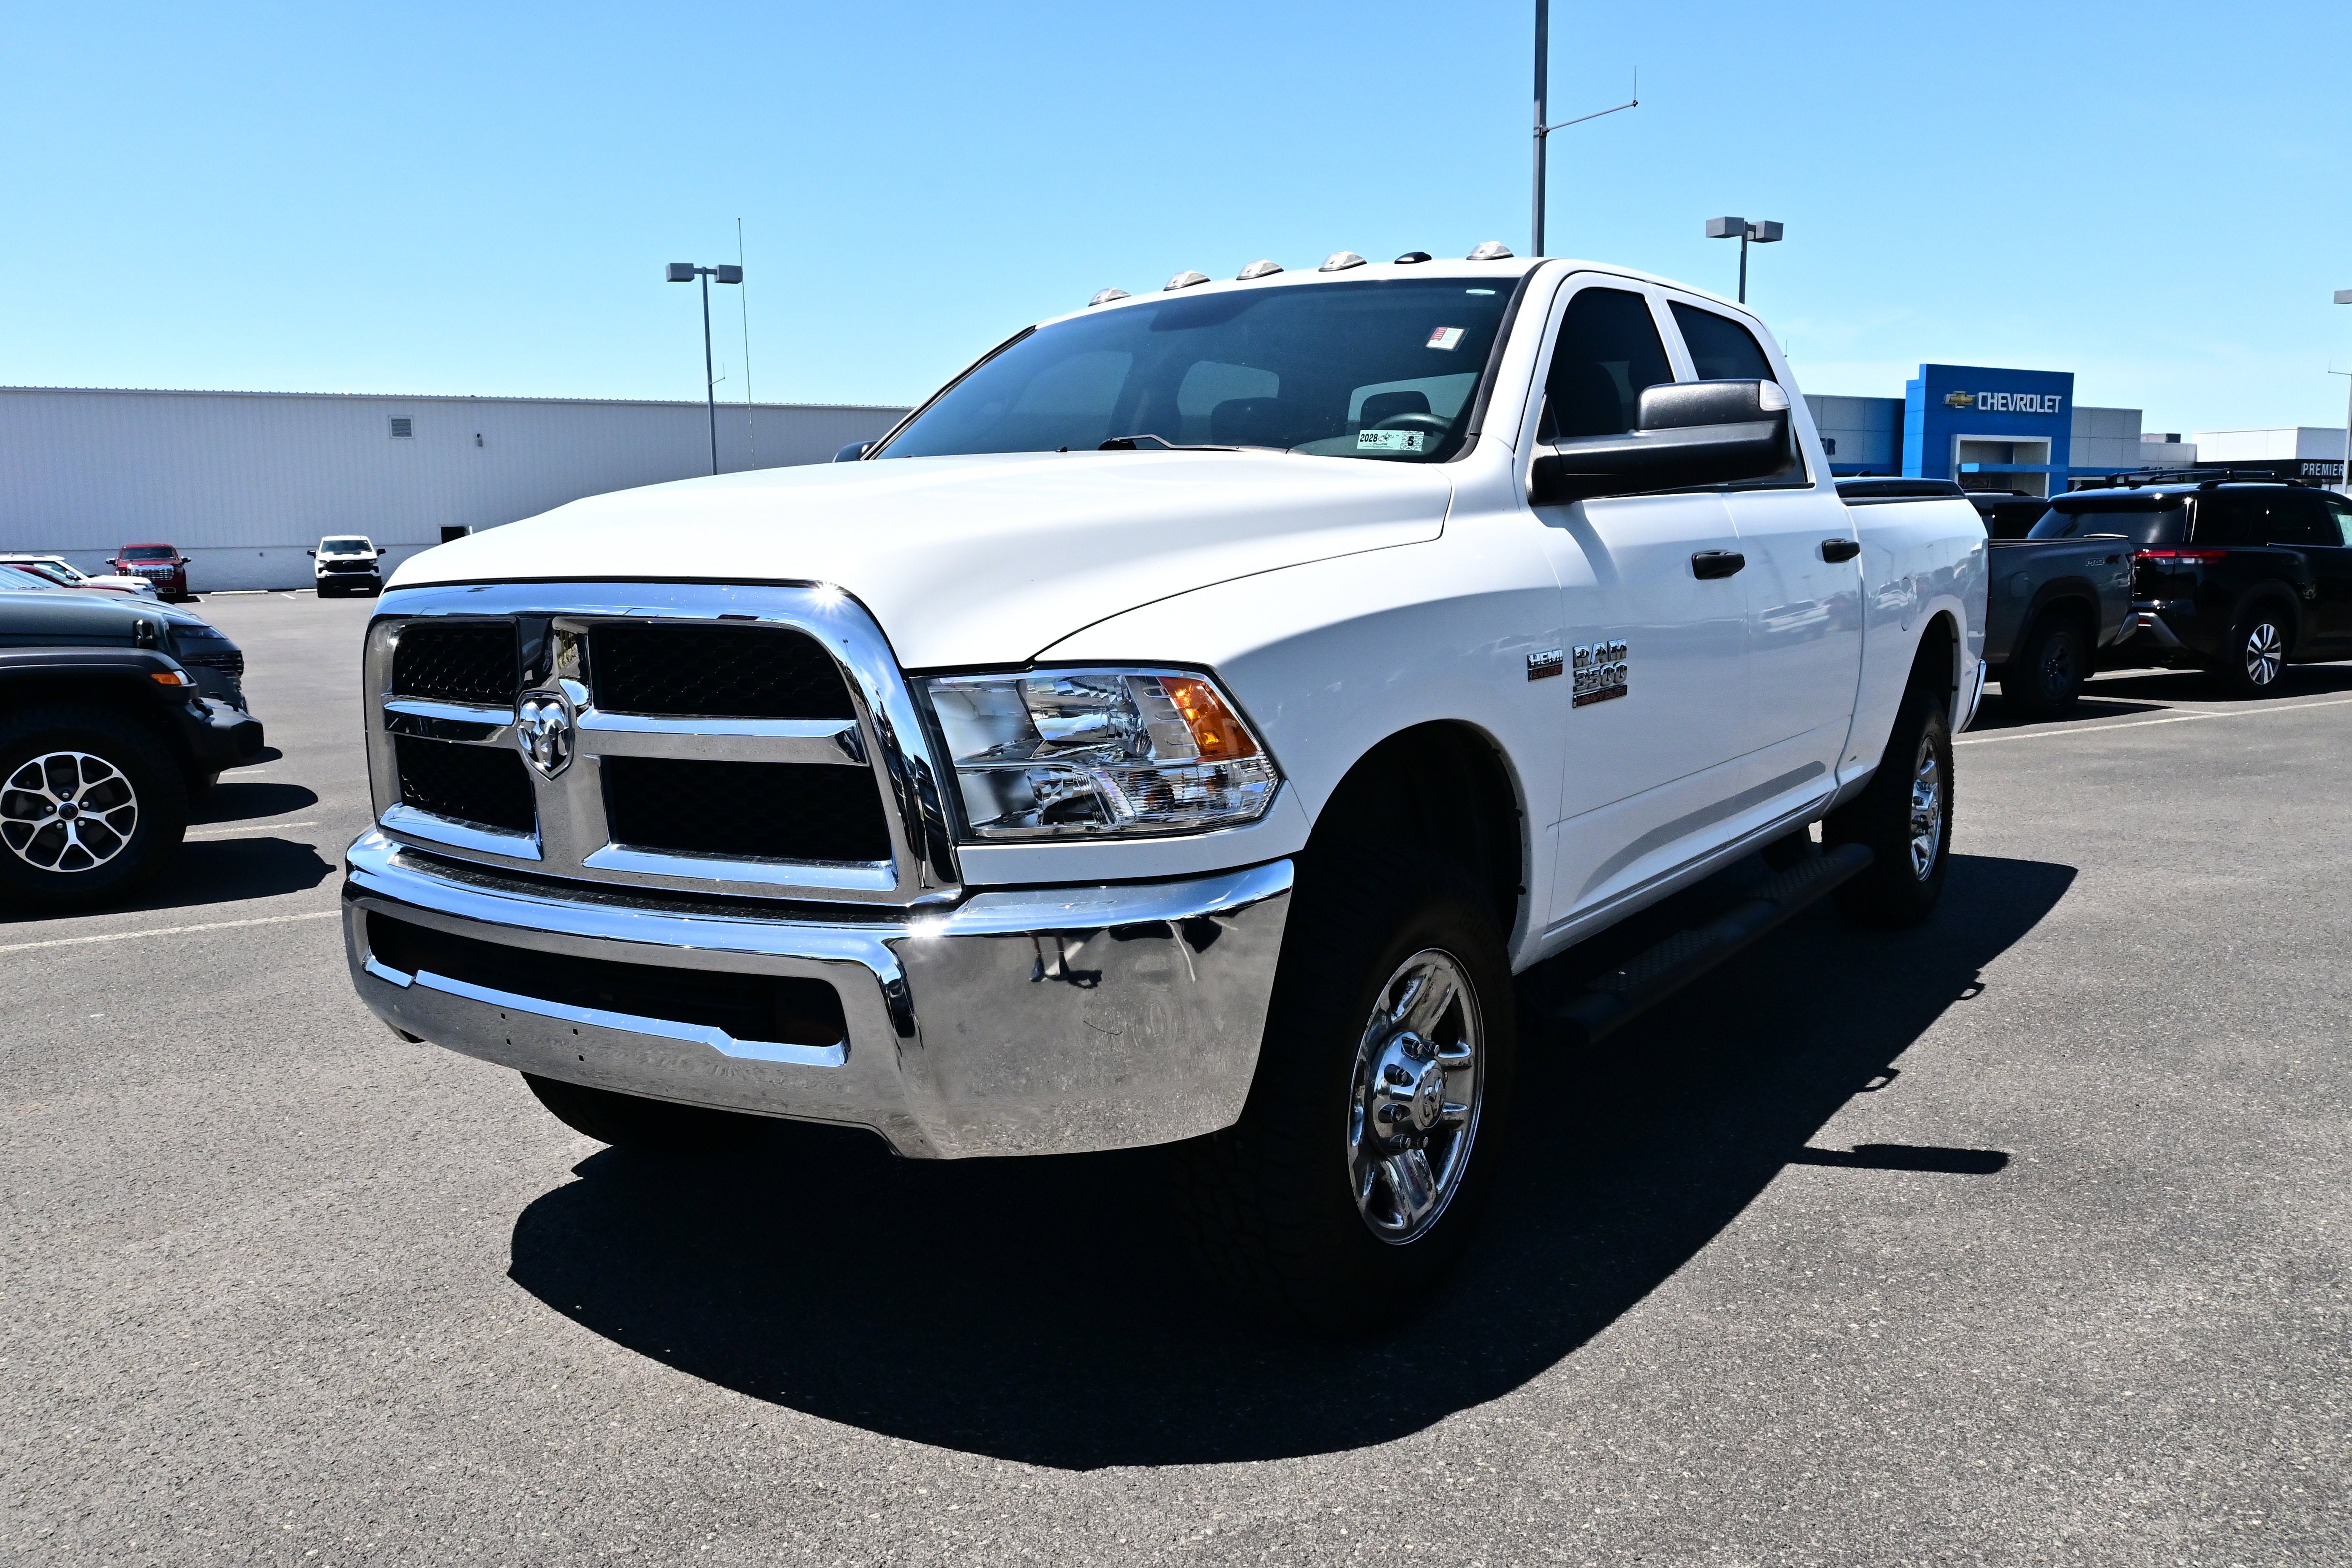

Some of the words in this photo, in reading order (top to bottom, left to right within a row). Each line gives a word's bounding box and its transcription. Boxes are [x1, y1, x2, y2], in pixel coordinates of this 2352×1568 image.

[1978, 392, 2062, 413] CHEVROLET
[1407, 436, 1414, 446] 5
[2302, 463, 2344, 476] PREMIER
[1527, 649, 1563, 667] HEMI
[1573, 639, 1627, 668] RAM
[1578, 691, 1604, 705] HEAVY
[1605, 686, 1626, 699] DUTY
